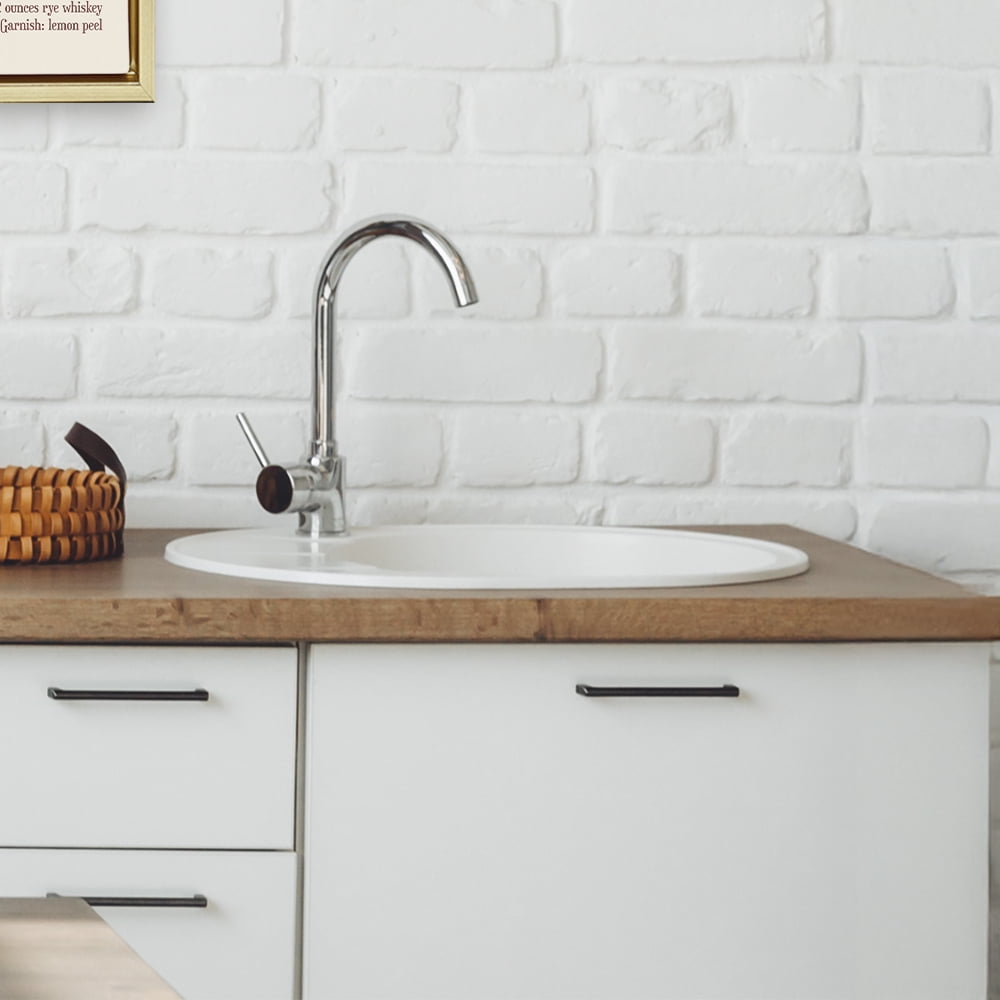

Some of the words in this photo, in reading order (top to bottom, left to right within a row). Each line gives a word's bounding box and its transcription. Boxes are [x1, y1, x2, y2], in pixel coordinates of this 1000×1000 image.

[5, 5, 39, 13] ounces
[43, 5, 59, 16] rye
[63, 1, 103, 16] whiskey
[0, 18, 45, 33] Garnish:
[48, 18, 79, 31] lemon
[82, 18, 103, 34] peel
